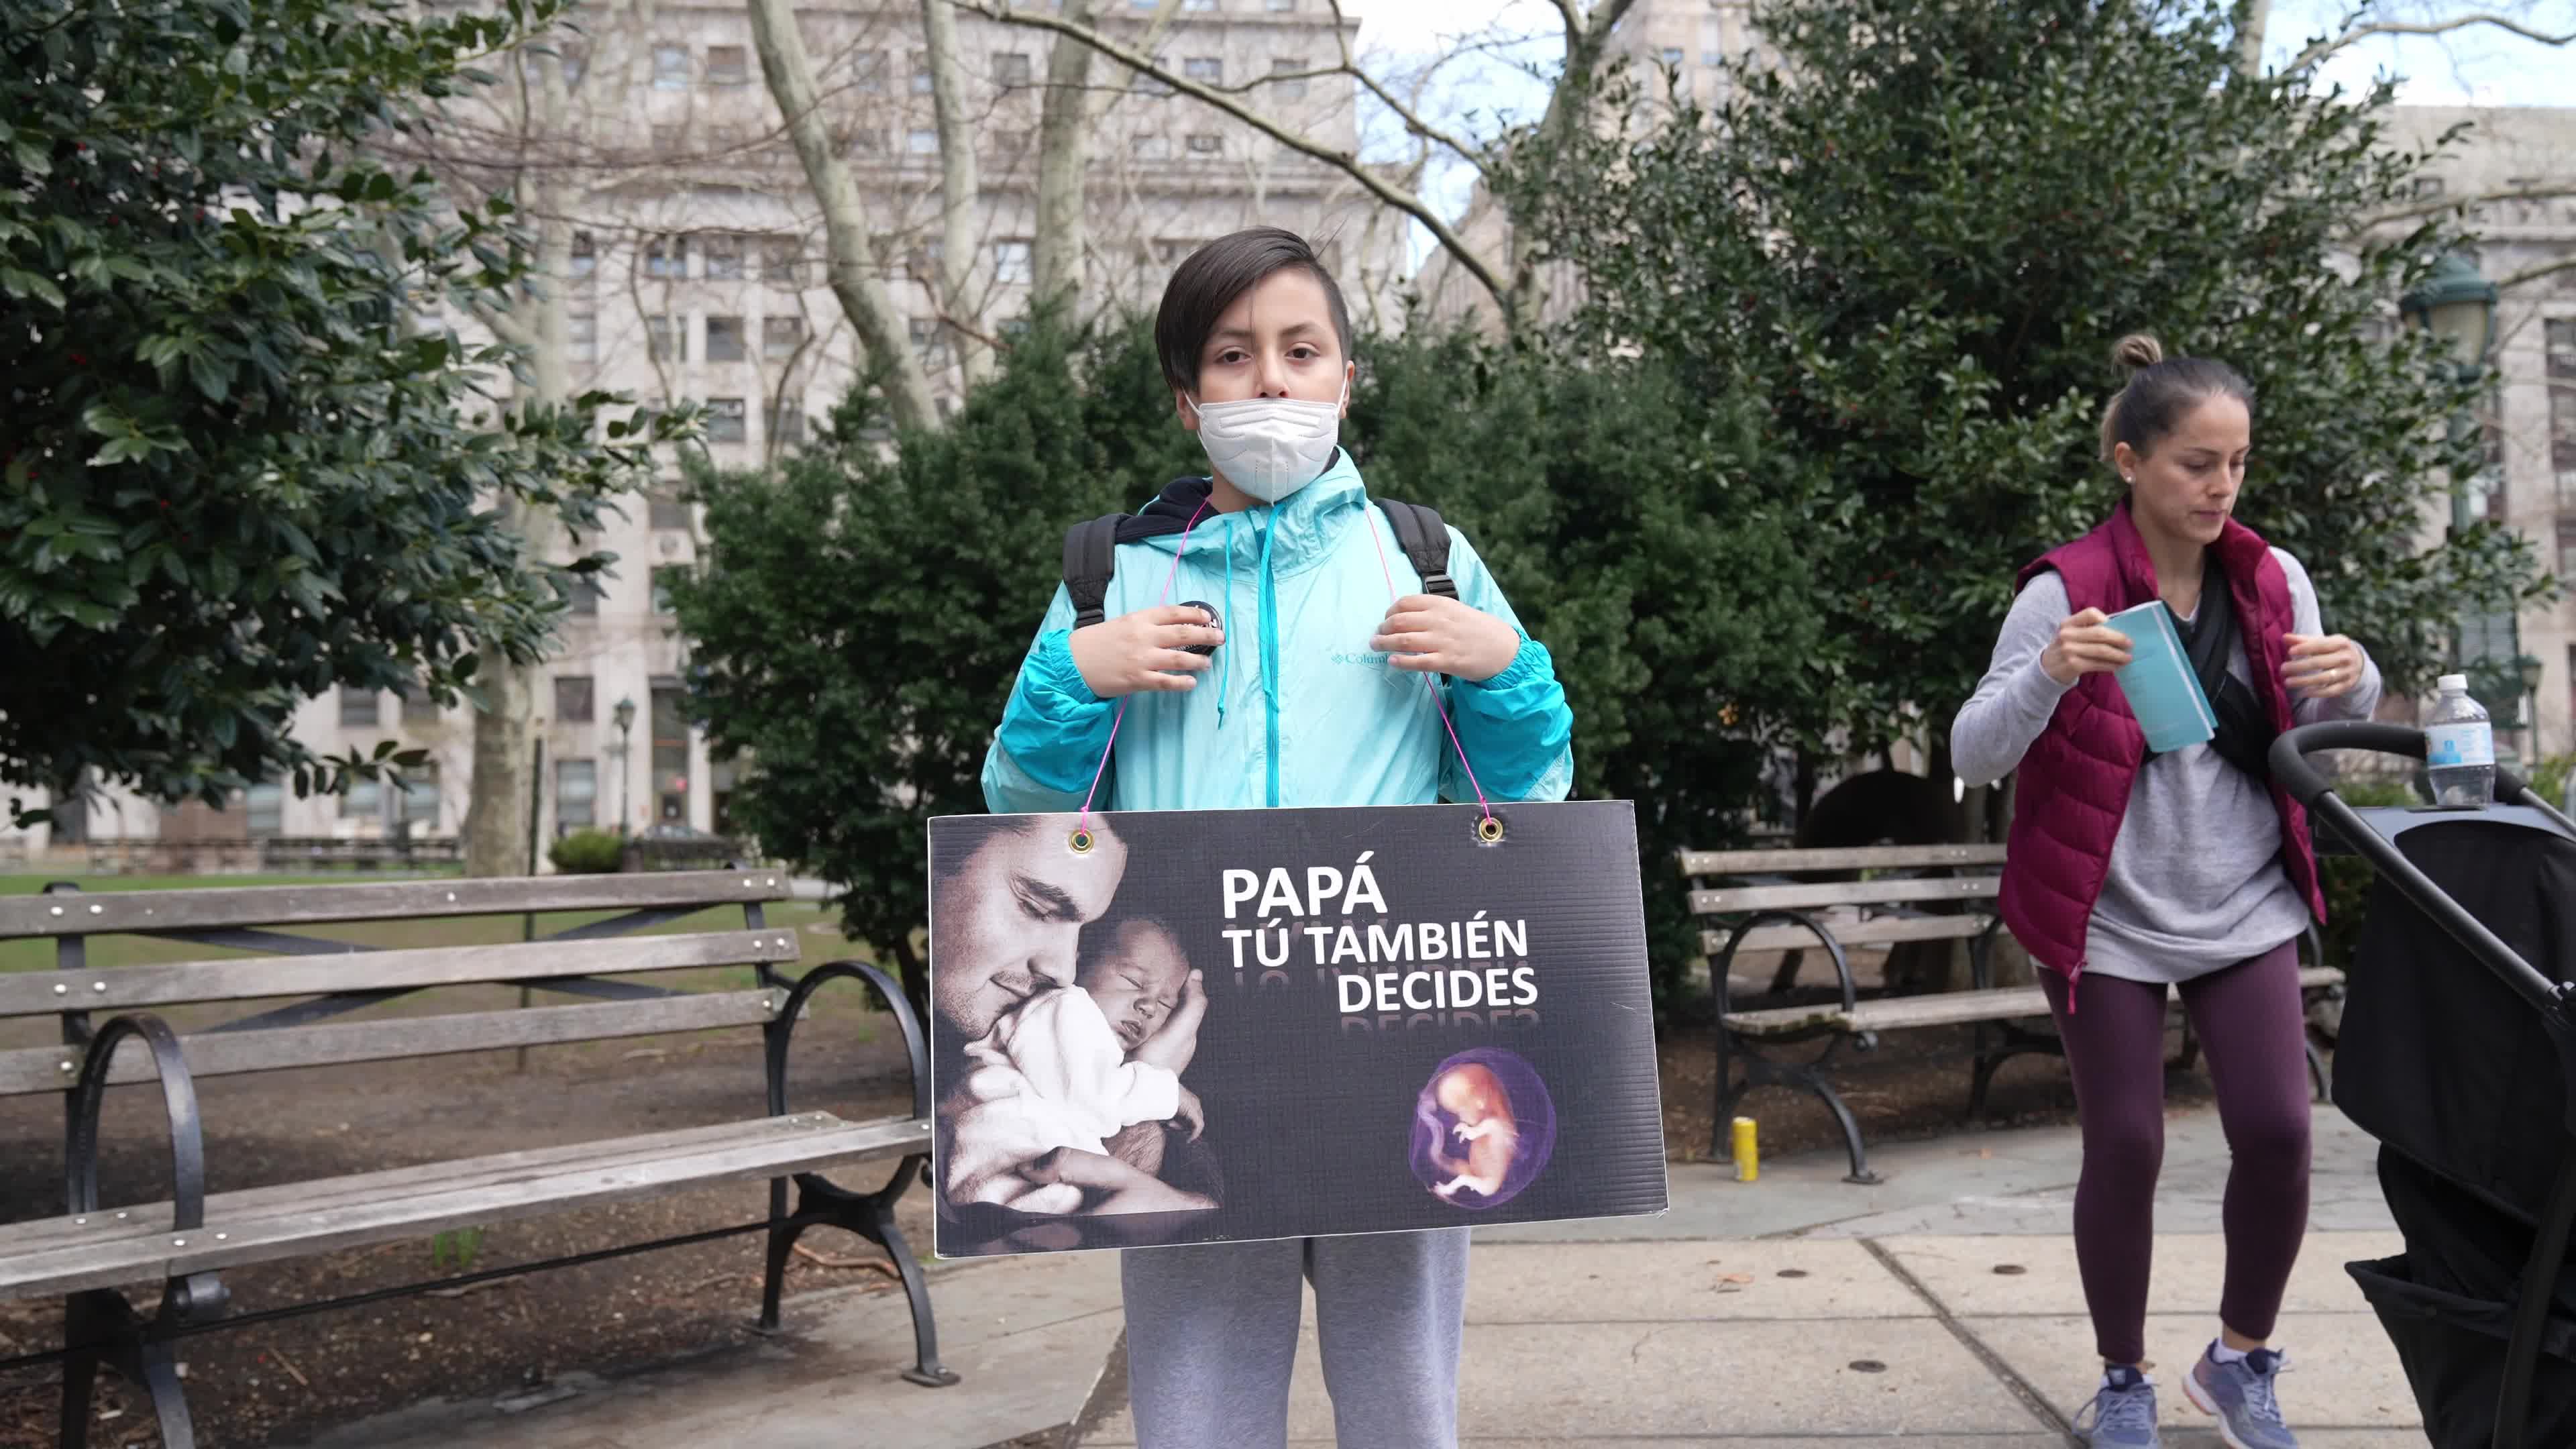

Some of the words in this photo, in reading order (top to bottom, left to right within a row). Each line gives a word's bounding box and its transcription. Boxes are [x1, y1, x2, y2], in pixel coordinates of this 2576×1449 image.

[1222, 850, 1388, 919] PAPÁ
[1222, 917, 1289, 968] TÚ
[1303, 910, 1527, 965] TAMBIÉN
[1338, 967, 1538, 1013] DECIDES
